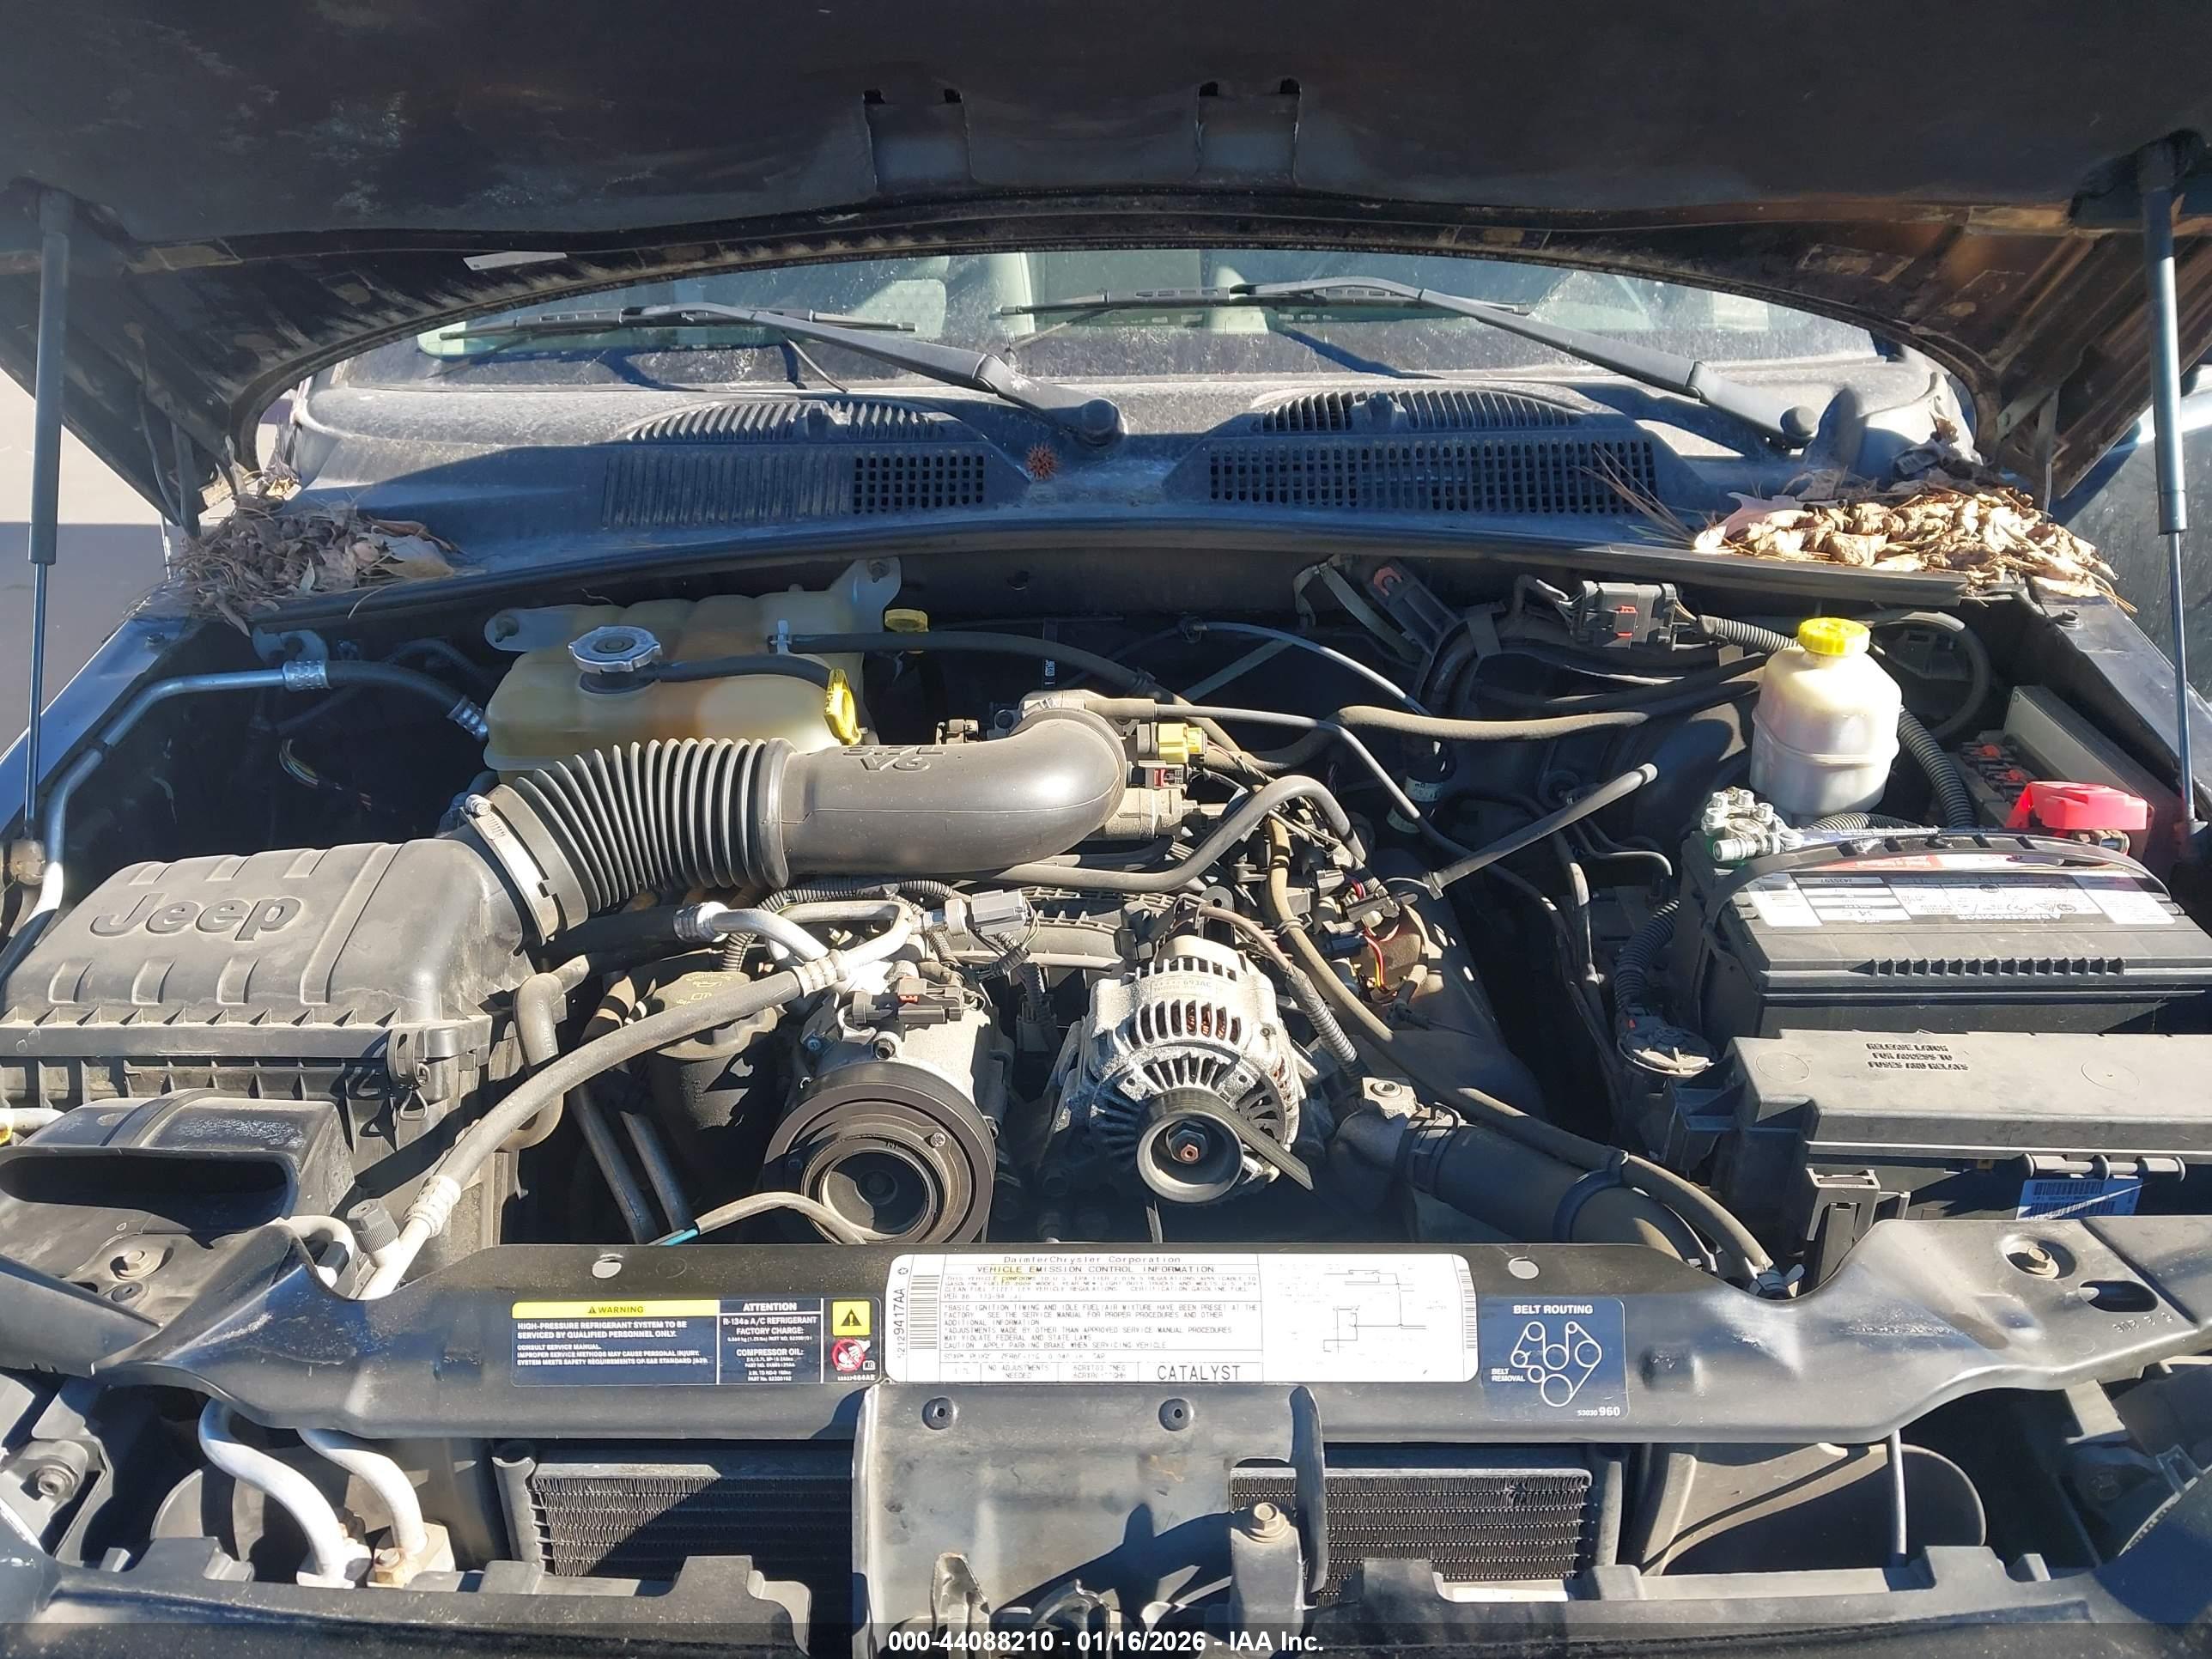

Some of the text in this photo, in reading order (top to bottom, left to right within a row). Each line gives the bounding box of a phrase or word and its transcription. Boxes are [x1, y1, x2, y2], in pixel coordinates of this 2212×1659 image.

[860, 757, 932, 773] V6
[89, 892, 304, 942] Jeep
[1865, 1042, 1914, 1051] RELEASE
[1868, 1060, 1903, 1069] FUSES
[1927, 1062, 1969, 1071] RELAYS
[1004, 1255, 1181, 1265] DaimlerChrysler Corporation
[598, 1305, 644, 1314] WARNING
[743, 1302, 798, 1312] ATTENTION
[1513, 1304, 1594, 1315] BELT ROUTING
[517, 1322, 580, 1330] HIGH-PRESSURE
[580, 1321, 633, 1329] REFRIGERANT
[722, 1316, 817, 1326] R-134a A/C REFRIGERANT
[736, 1348, 788, 1357] COMPRESSOR
[1157, 1364, 1241, 1381] CATALYST
